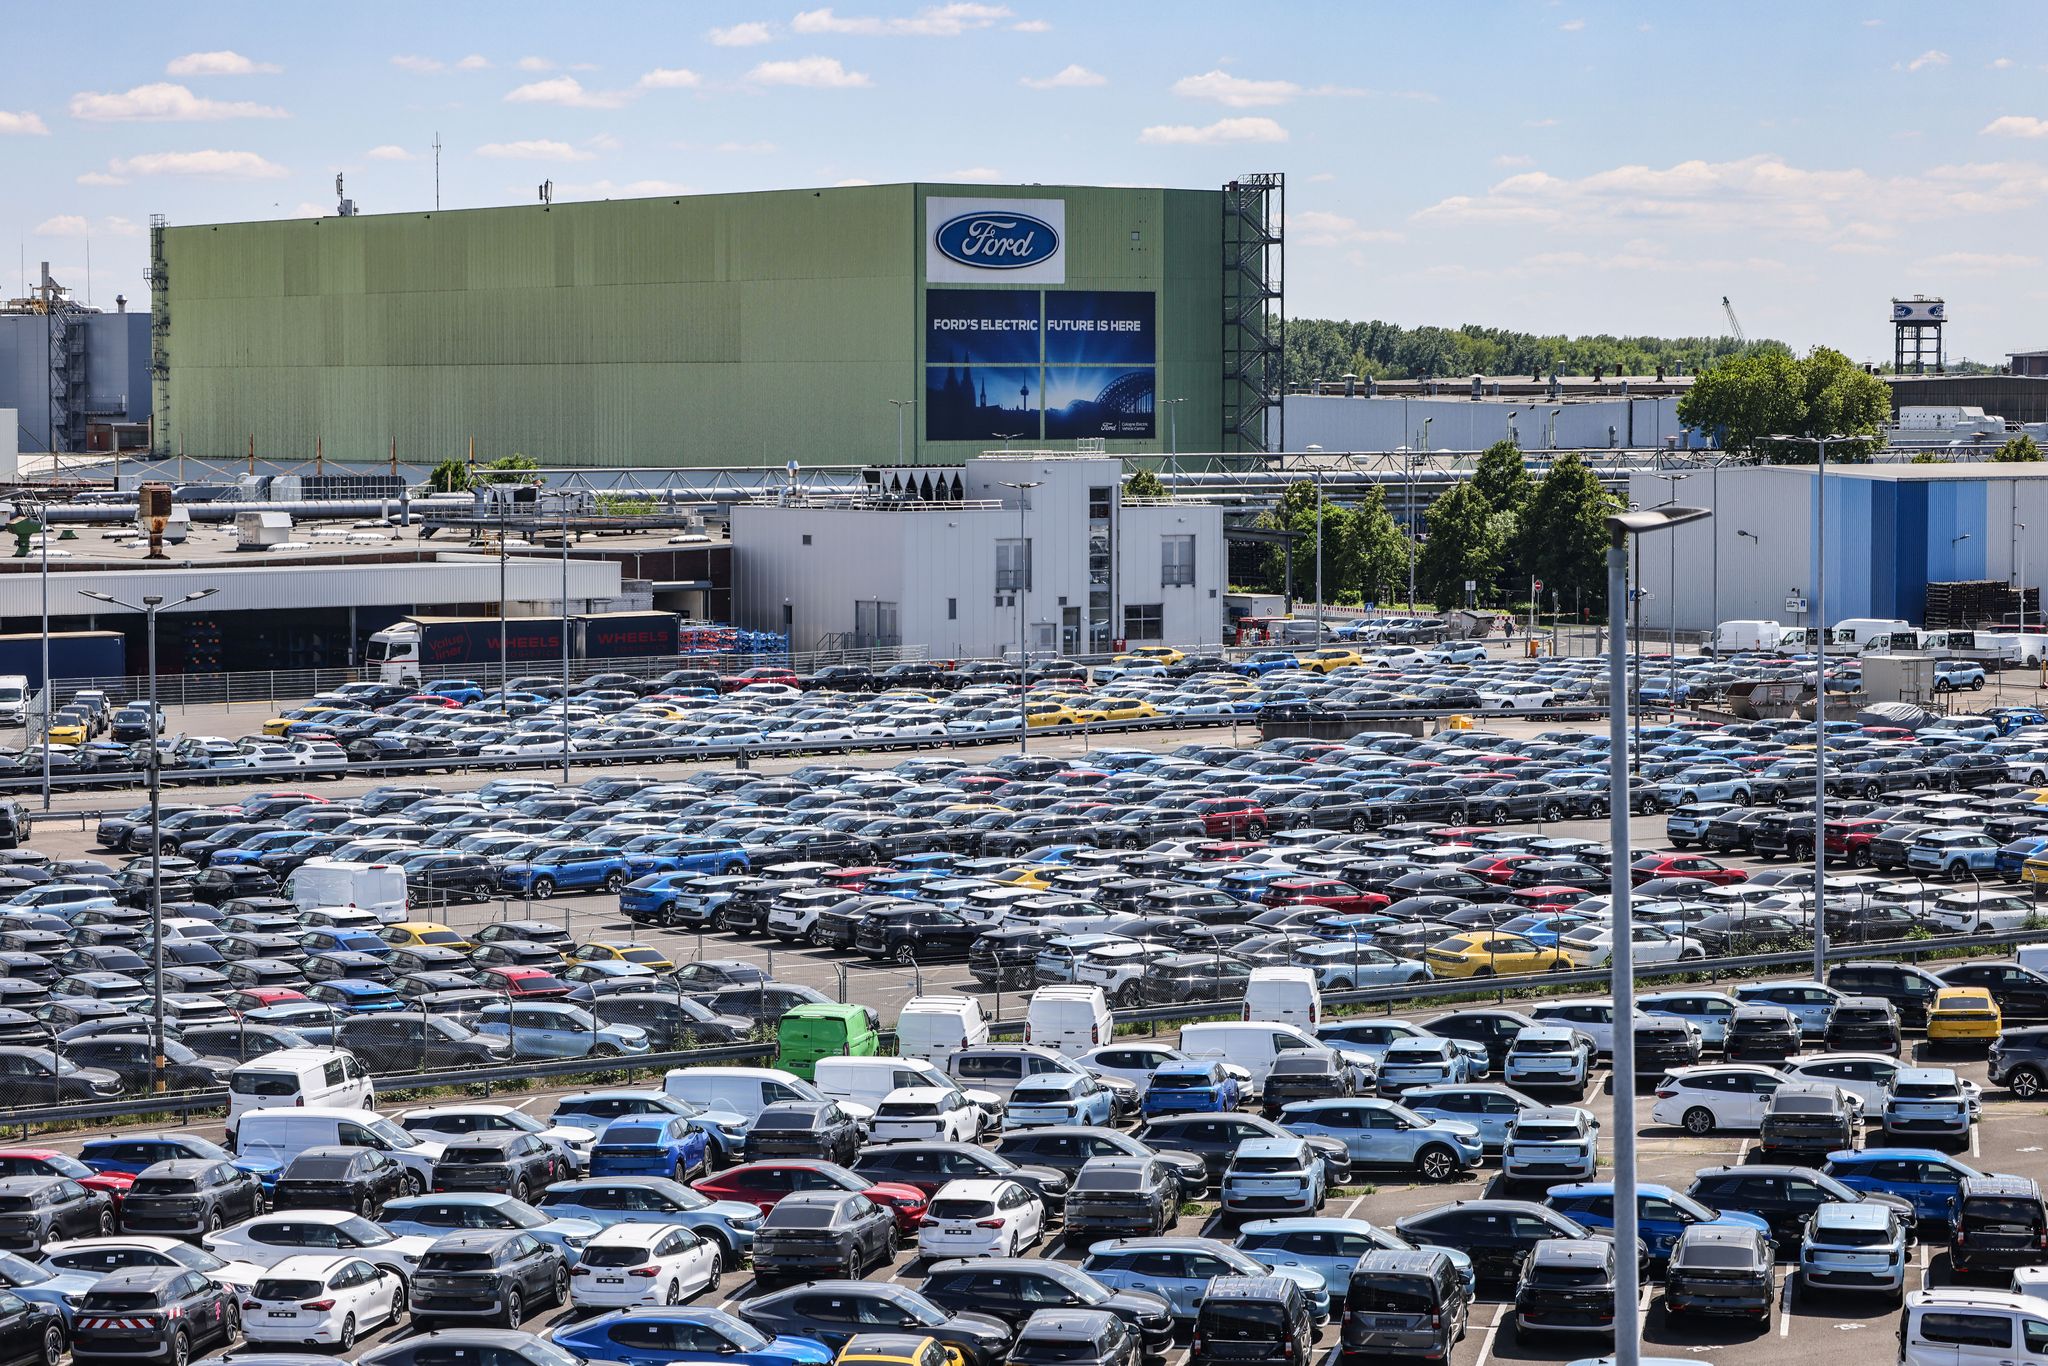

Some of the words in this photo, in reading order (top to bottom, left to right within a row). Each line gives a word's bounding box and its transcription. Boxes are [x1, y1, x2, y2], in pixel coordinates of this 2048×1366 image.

[961, 219, 1035, 257] Ford
[933, 318, 979, 331] FORD'S
[980, 319, 1039, 331] ELECTRIC
[1047, 319, 1095, 332] FUTURE
[1096, 320, 1109, 332] IS
[1110, 320, 1141, 332] HERE
[1100, 422, 1117, 431] Ford
[428, 634, 465, 651] Value
[486, 635, 560, 650] WHEELS
[597, 631, 669, 645] WHEELS
